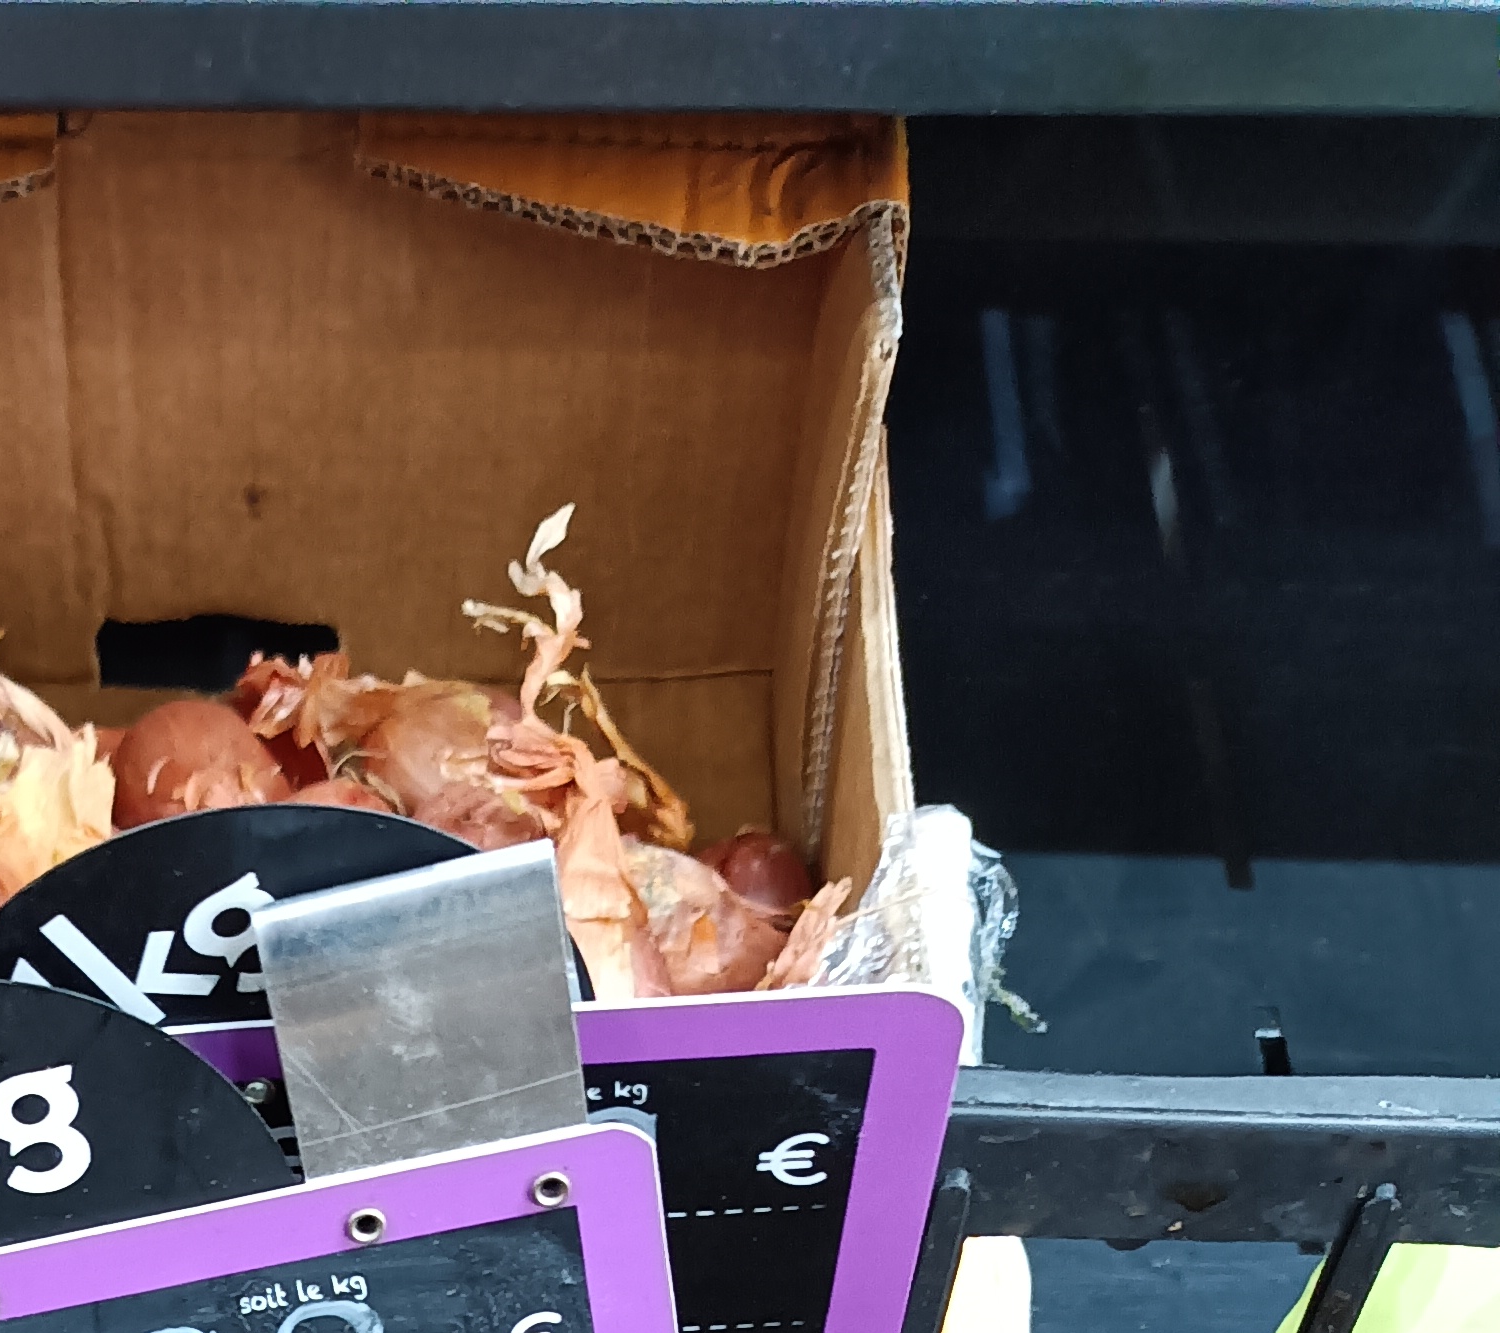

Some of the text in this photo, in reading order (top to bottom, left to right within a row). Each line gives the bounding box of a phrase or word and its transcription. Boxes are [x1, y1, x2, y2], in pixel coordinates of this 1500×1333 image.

[614, 1081, 649, 1105] kg
[756, 1132, 831, 1186] €
[239, 1273, 368, 1315] soit le kg
